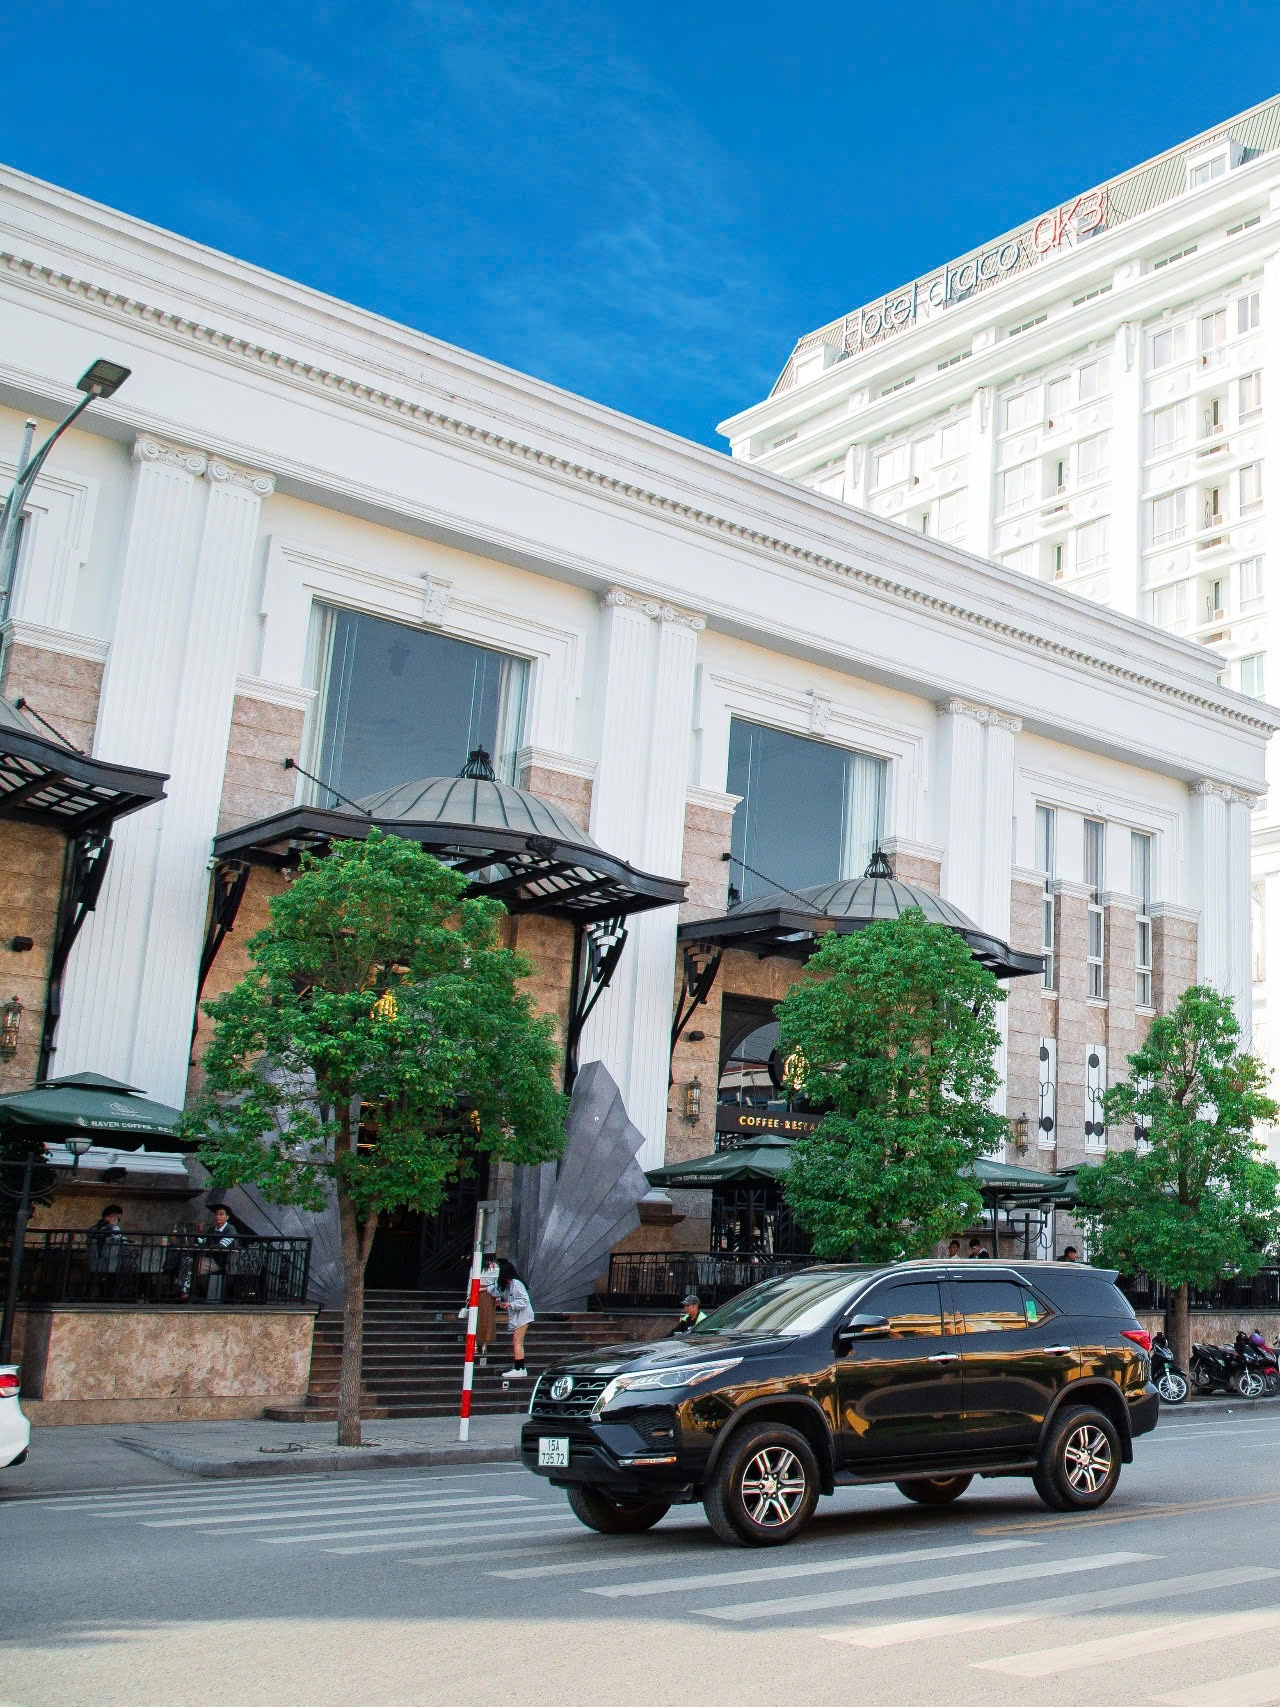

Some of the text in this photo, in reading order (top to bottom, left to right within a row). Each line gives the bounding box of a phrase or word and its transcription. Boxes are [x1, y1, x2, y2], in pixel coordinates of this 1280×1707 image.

[841, 281, 918, 351] Hotel
[927, 242, 1021, 308] draco
[91, 1120, 120, 1129] HAVEN
[547, 1440, 560, 1452] 15A
[541, 1453, 565, 1465] 735.72
